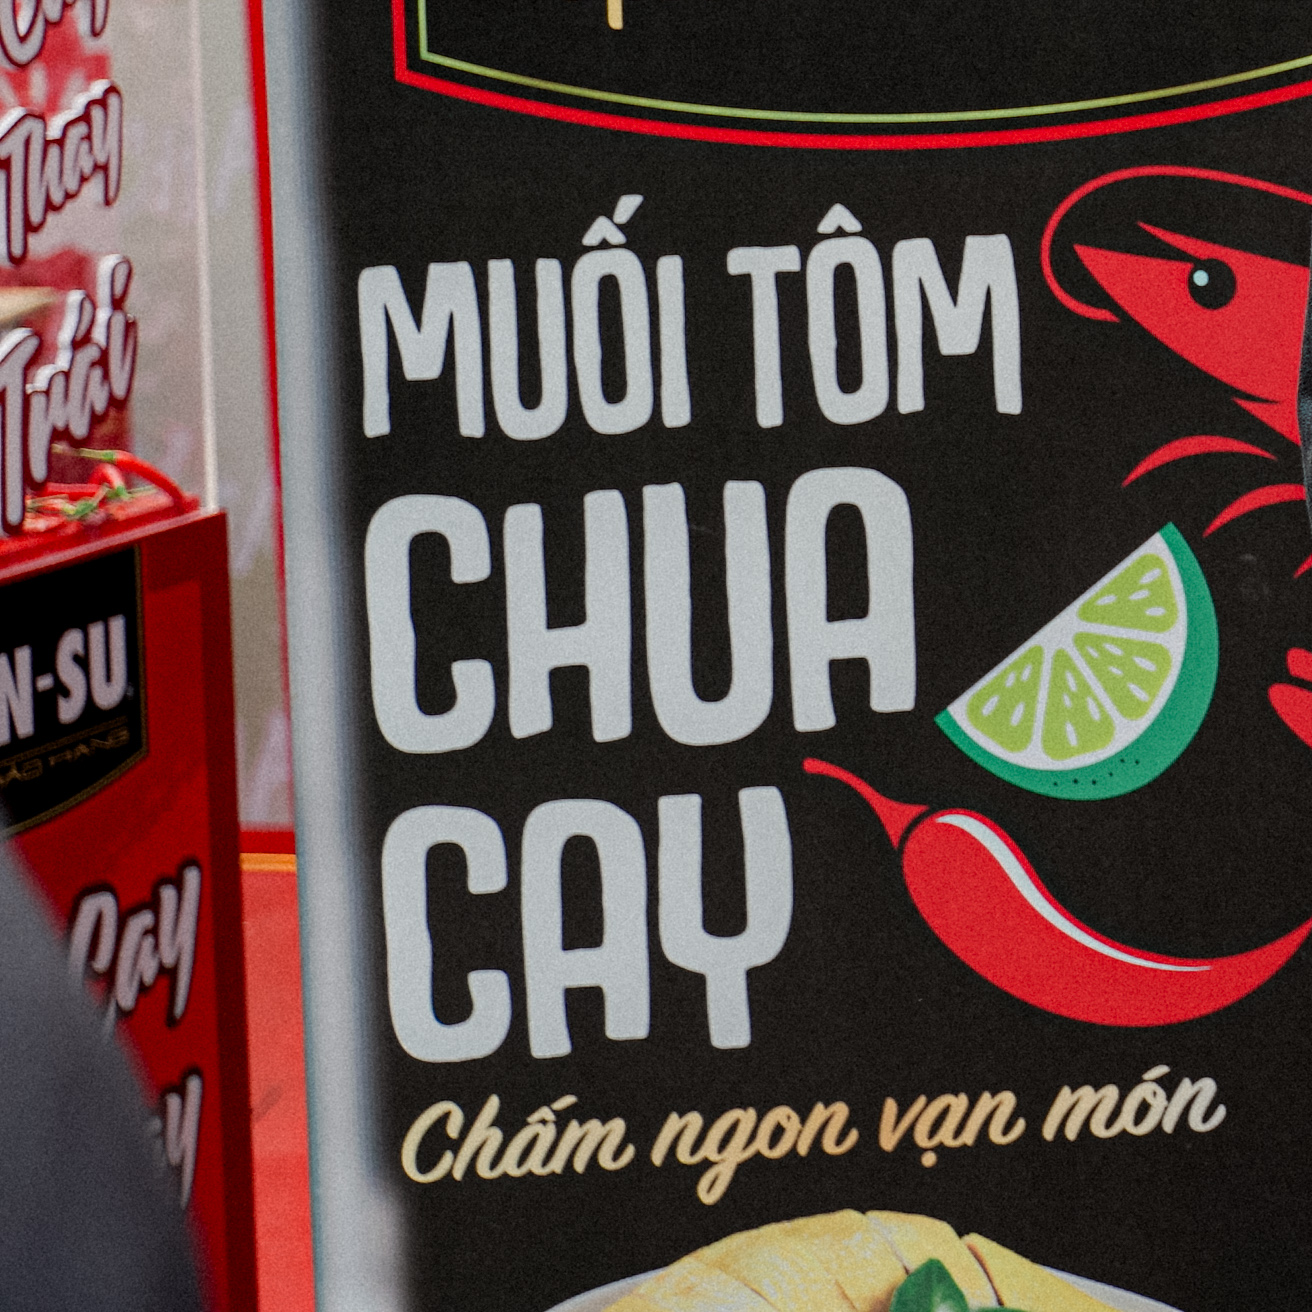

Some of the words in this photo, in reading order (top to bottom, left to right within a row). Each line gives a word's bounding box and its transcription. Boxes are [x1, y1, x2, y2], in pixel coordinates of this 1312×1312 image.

[357, 193, 693, 441] MUỐI
[727, 202, 1023, 426] TÔM
[363, 465, 918, 755] CHUA
[380, 785, 794, 1063] CAY
[401, 1094, 636, 1183] Chấm
[651, 1098, 859, 1206] ngon
[877, 1091, 1024, 1168] vạn
[1041, 1063, 1227, 1143] món
